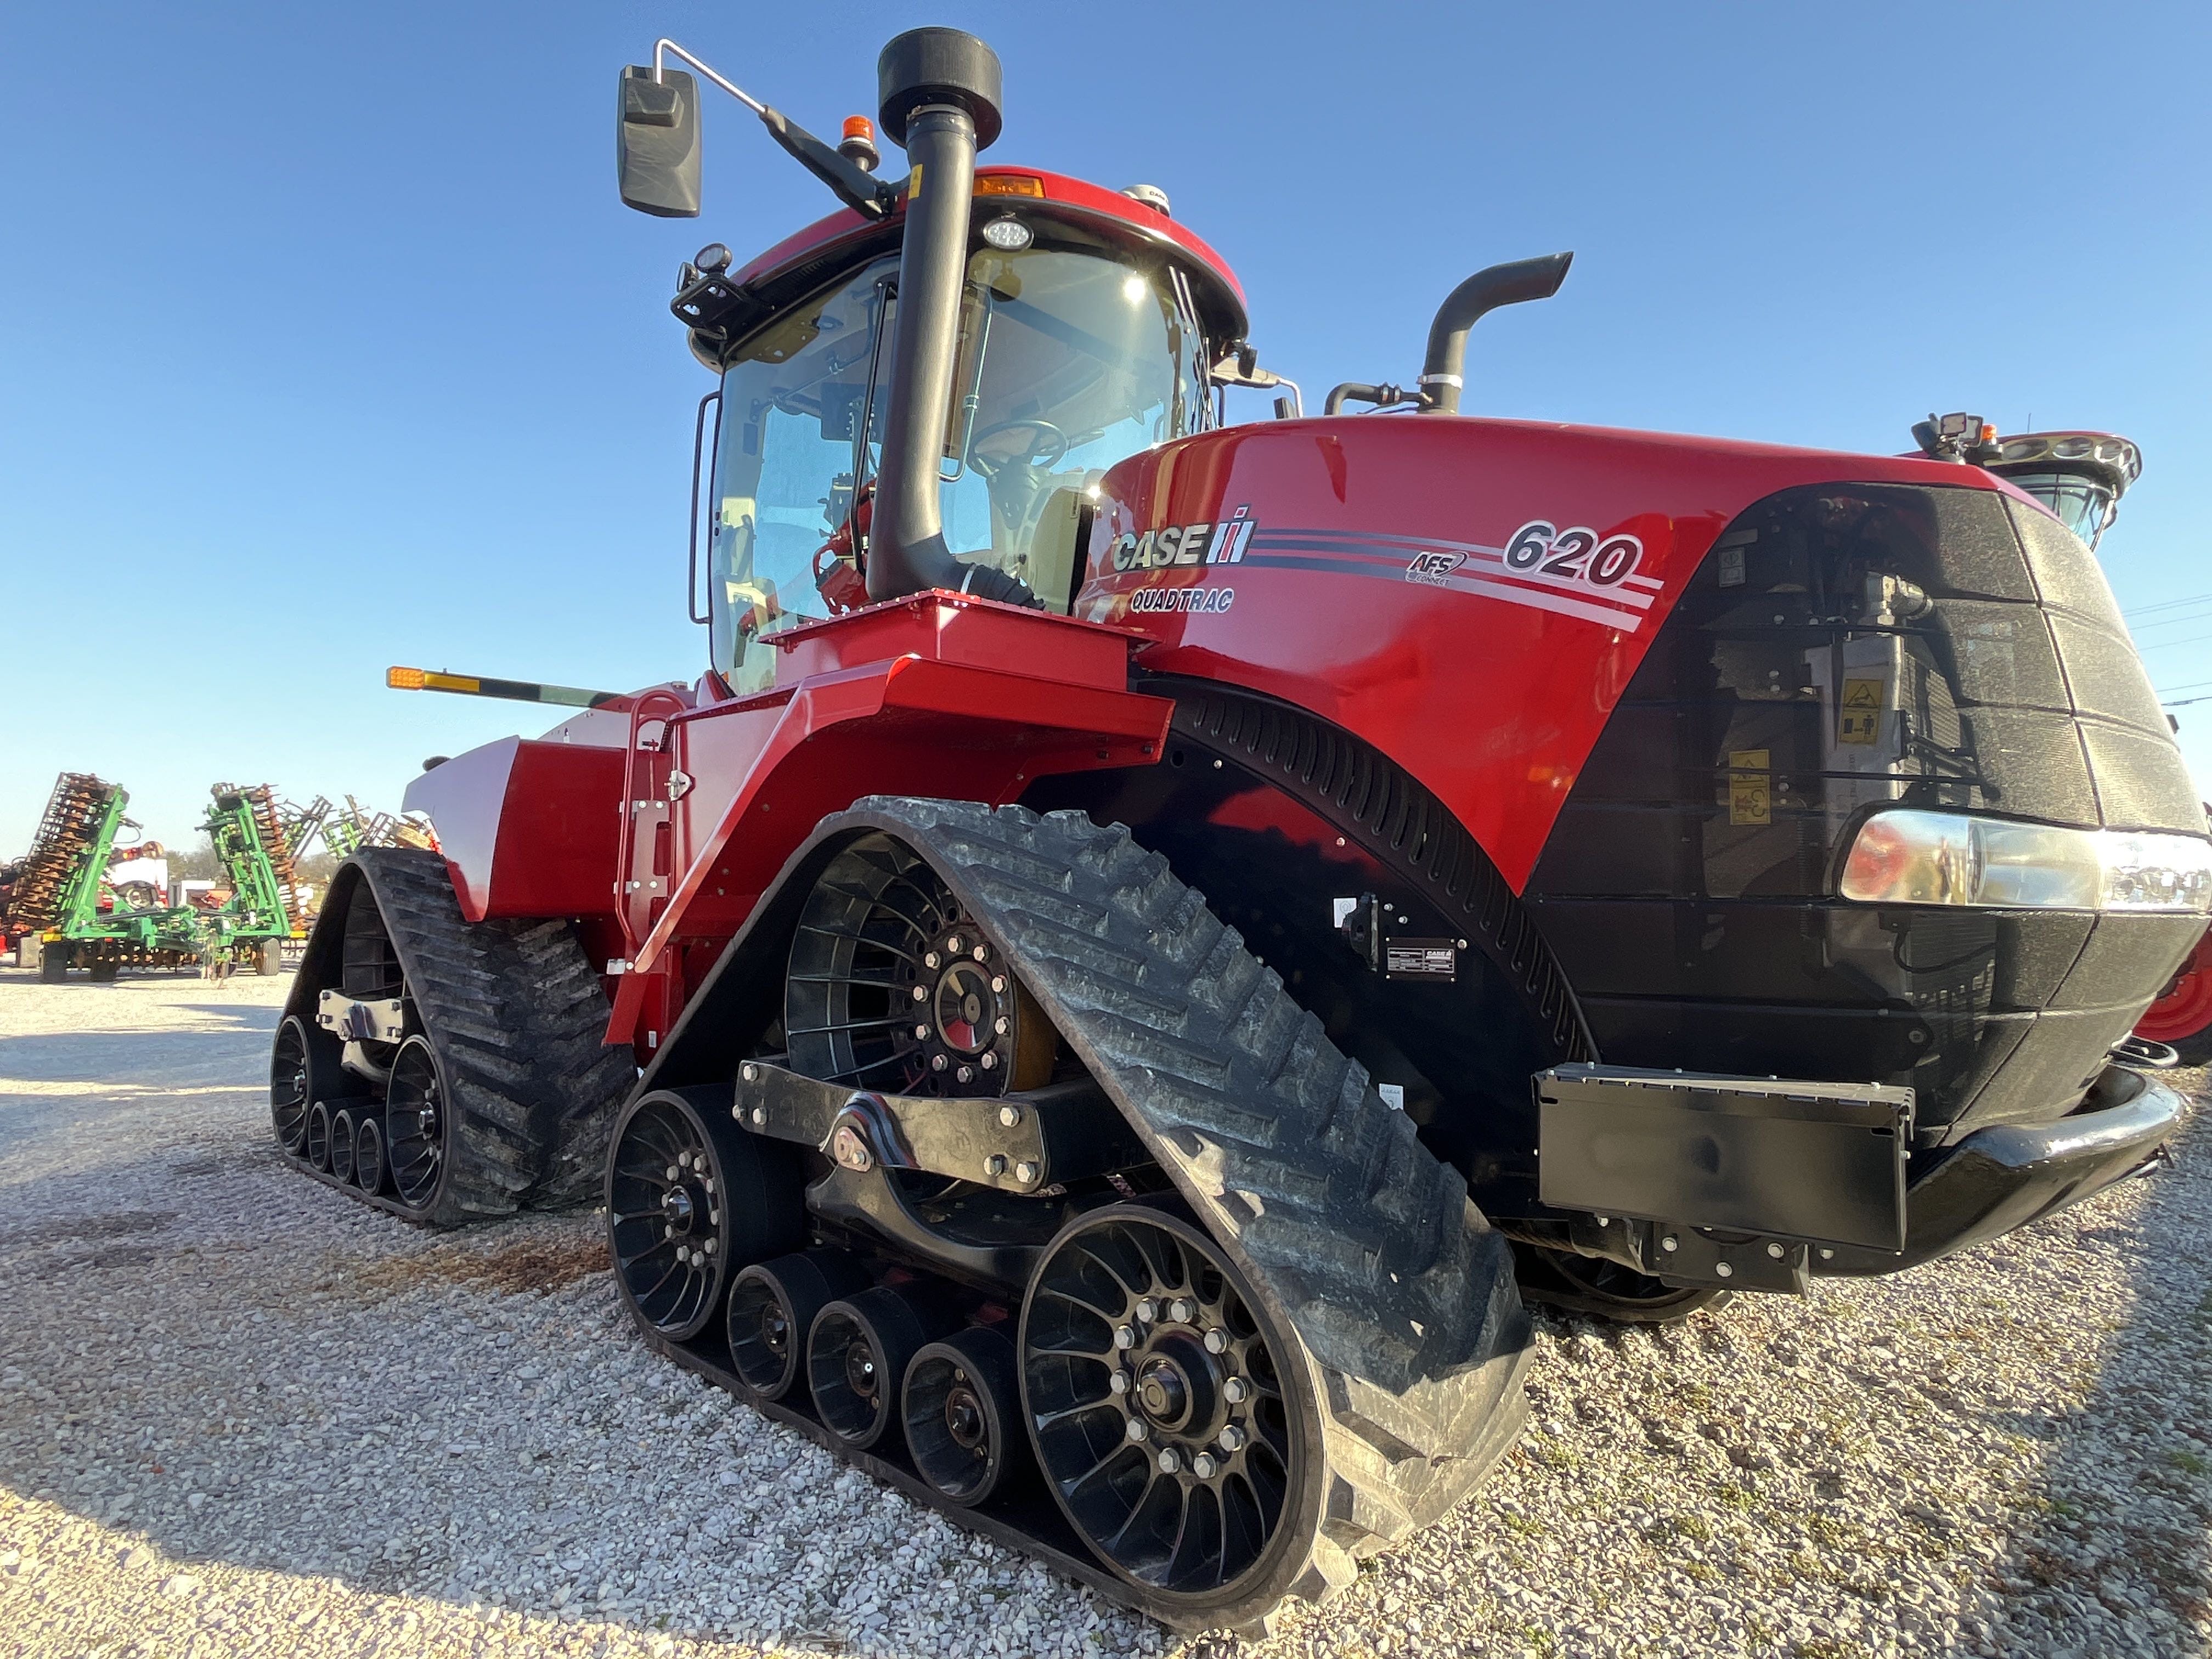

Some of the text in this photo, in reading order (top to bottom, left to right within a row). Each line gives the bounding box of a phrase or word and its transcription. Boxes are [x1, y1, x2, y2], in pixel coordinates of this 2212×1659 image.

[1113, 523, 1210, 571] CASE
[1406, 551, 1456, 575] AFS
[1502, 520, 1644, 589] 620
[1131, 587, 1235, 614] QUADTRAC
